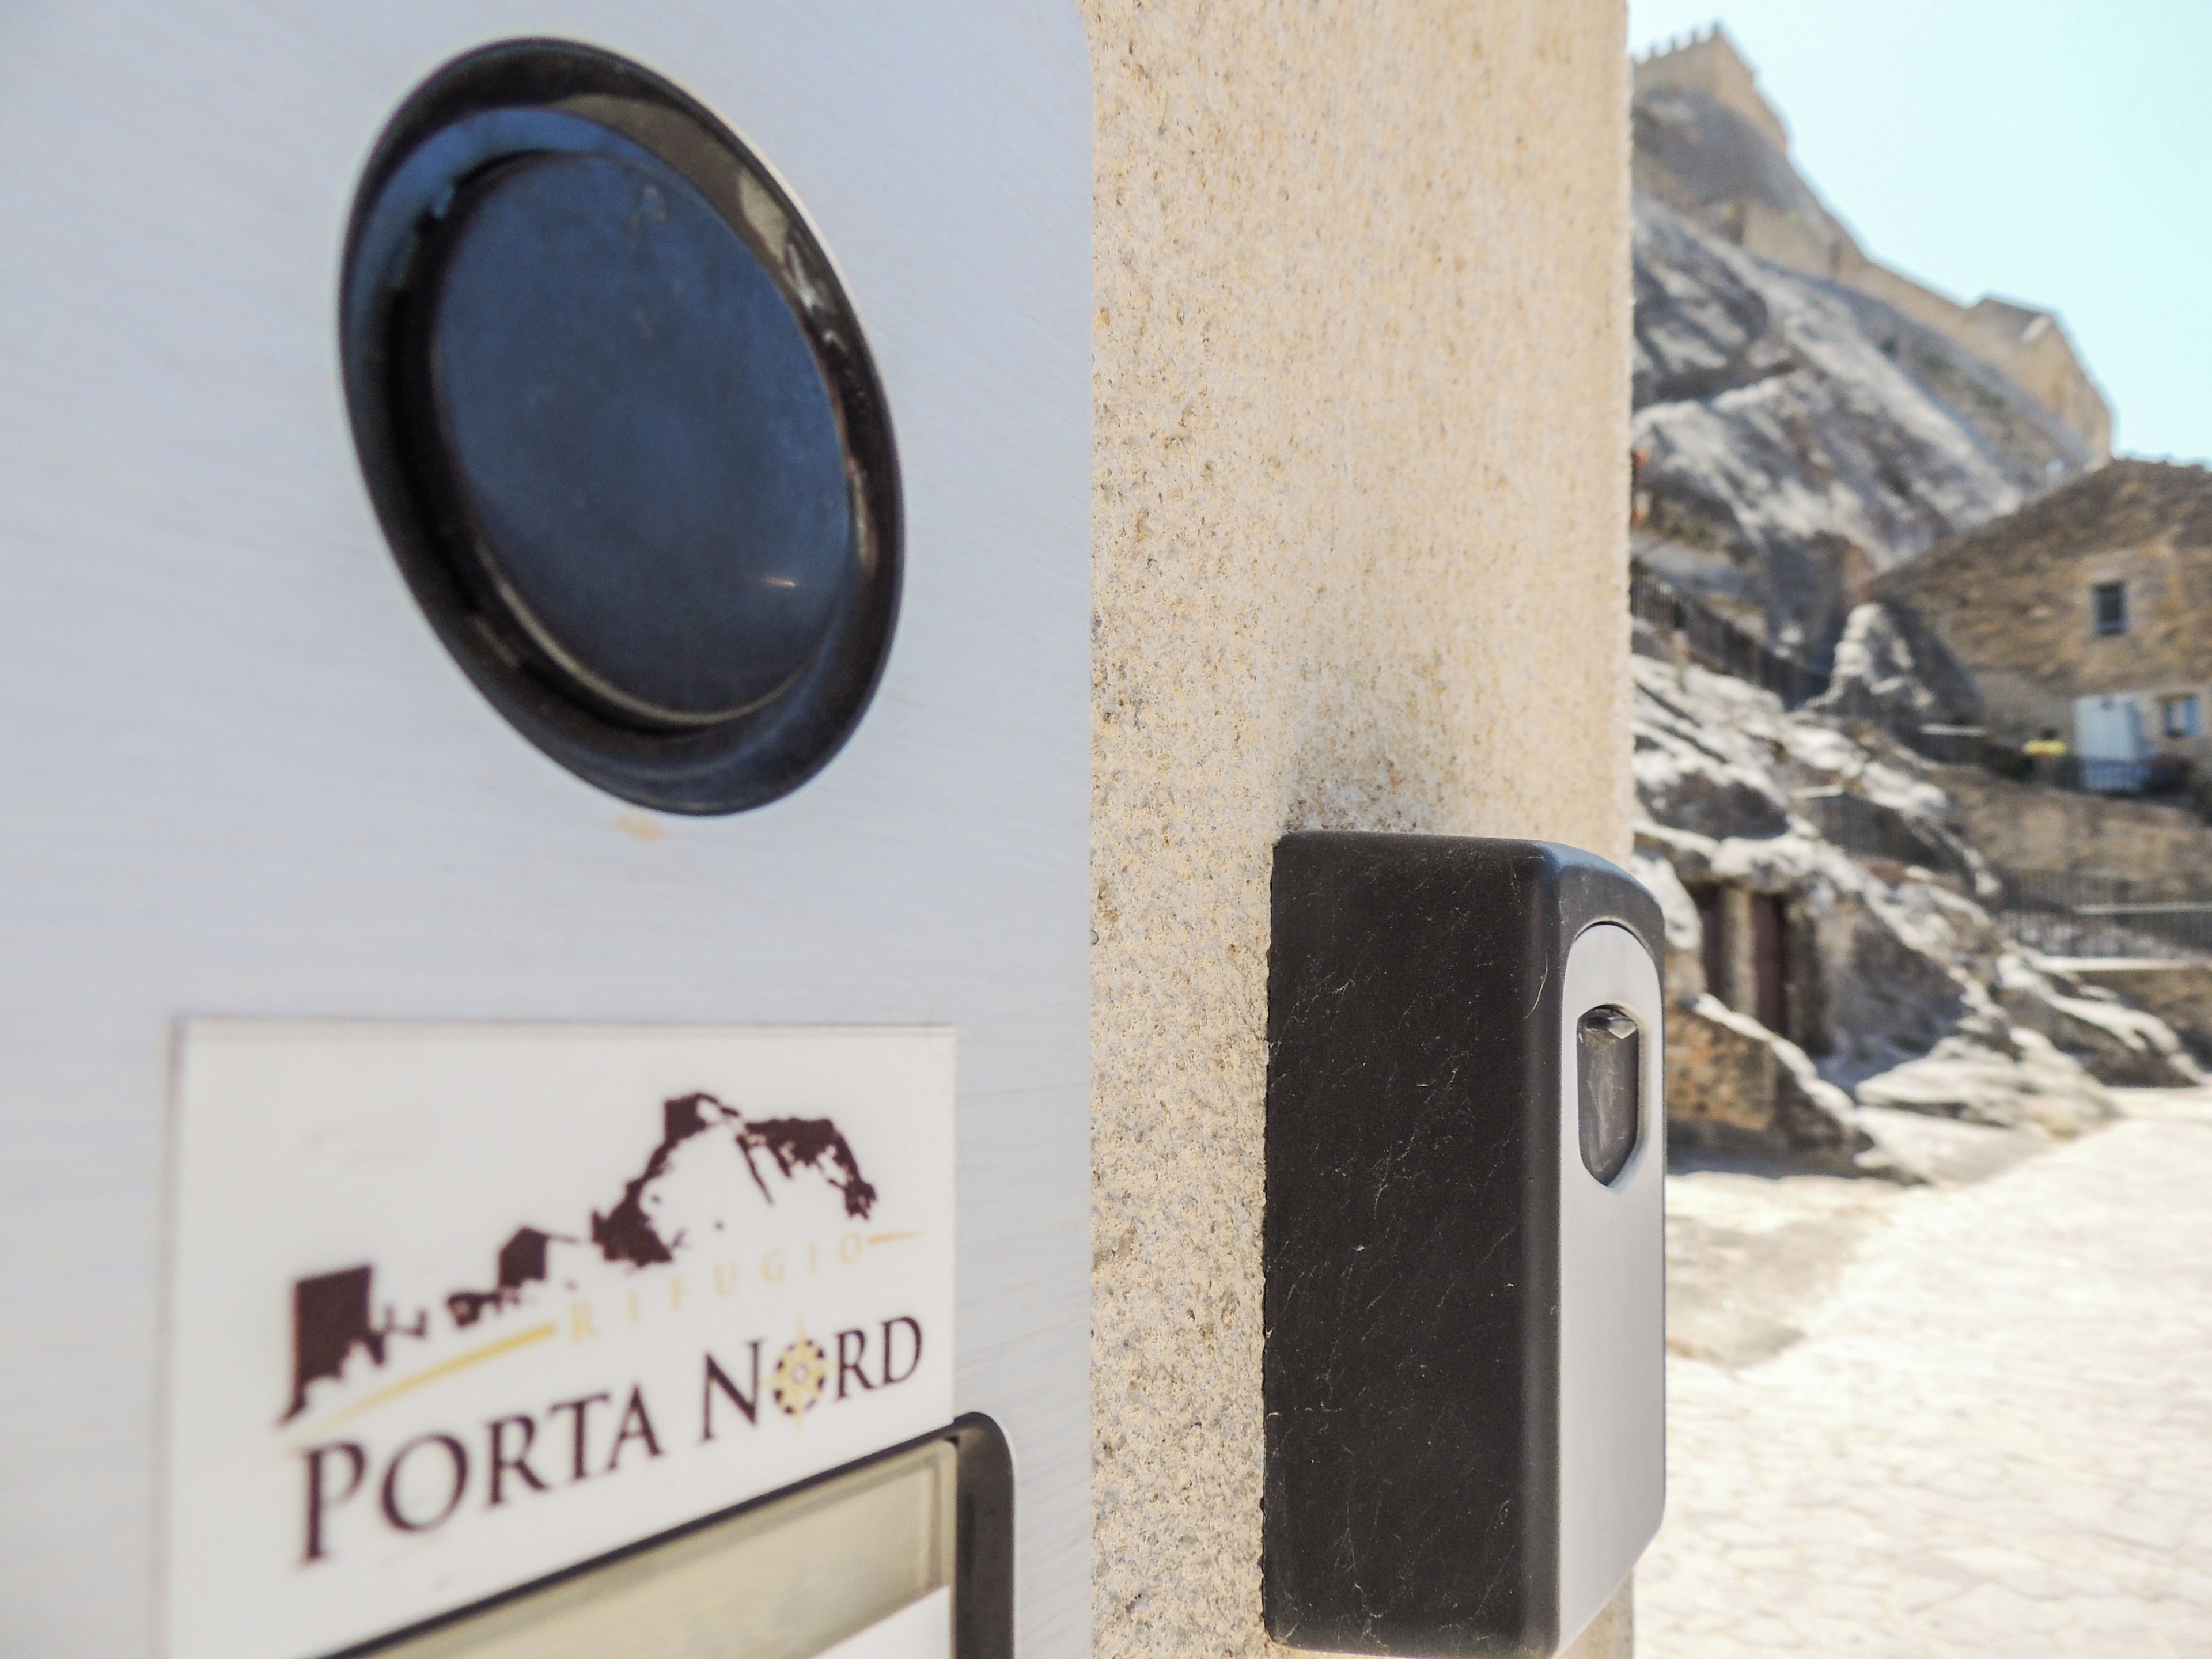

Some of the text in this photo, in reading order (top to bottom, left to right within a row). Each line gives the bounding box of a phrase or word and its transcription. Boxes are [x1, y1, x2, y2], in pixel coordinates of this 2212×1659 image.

[566, 1232, 863, 1346] RIFUGIO
[298, 1316, 923, 1567] PORTA NORD
